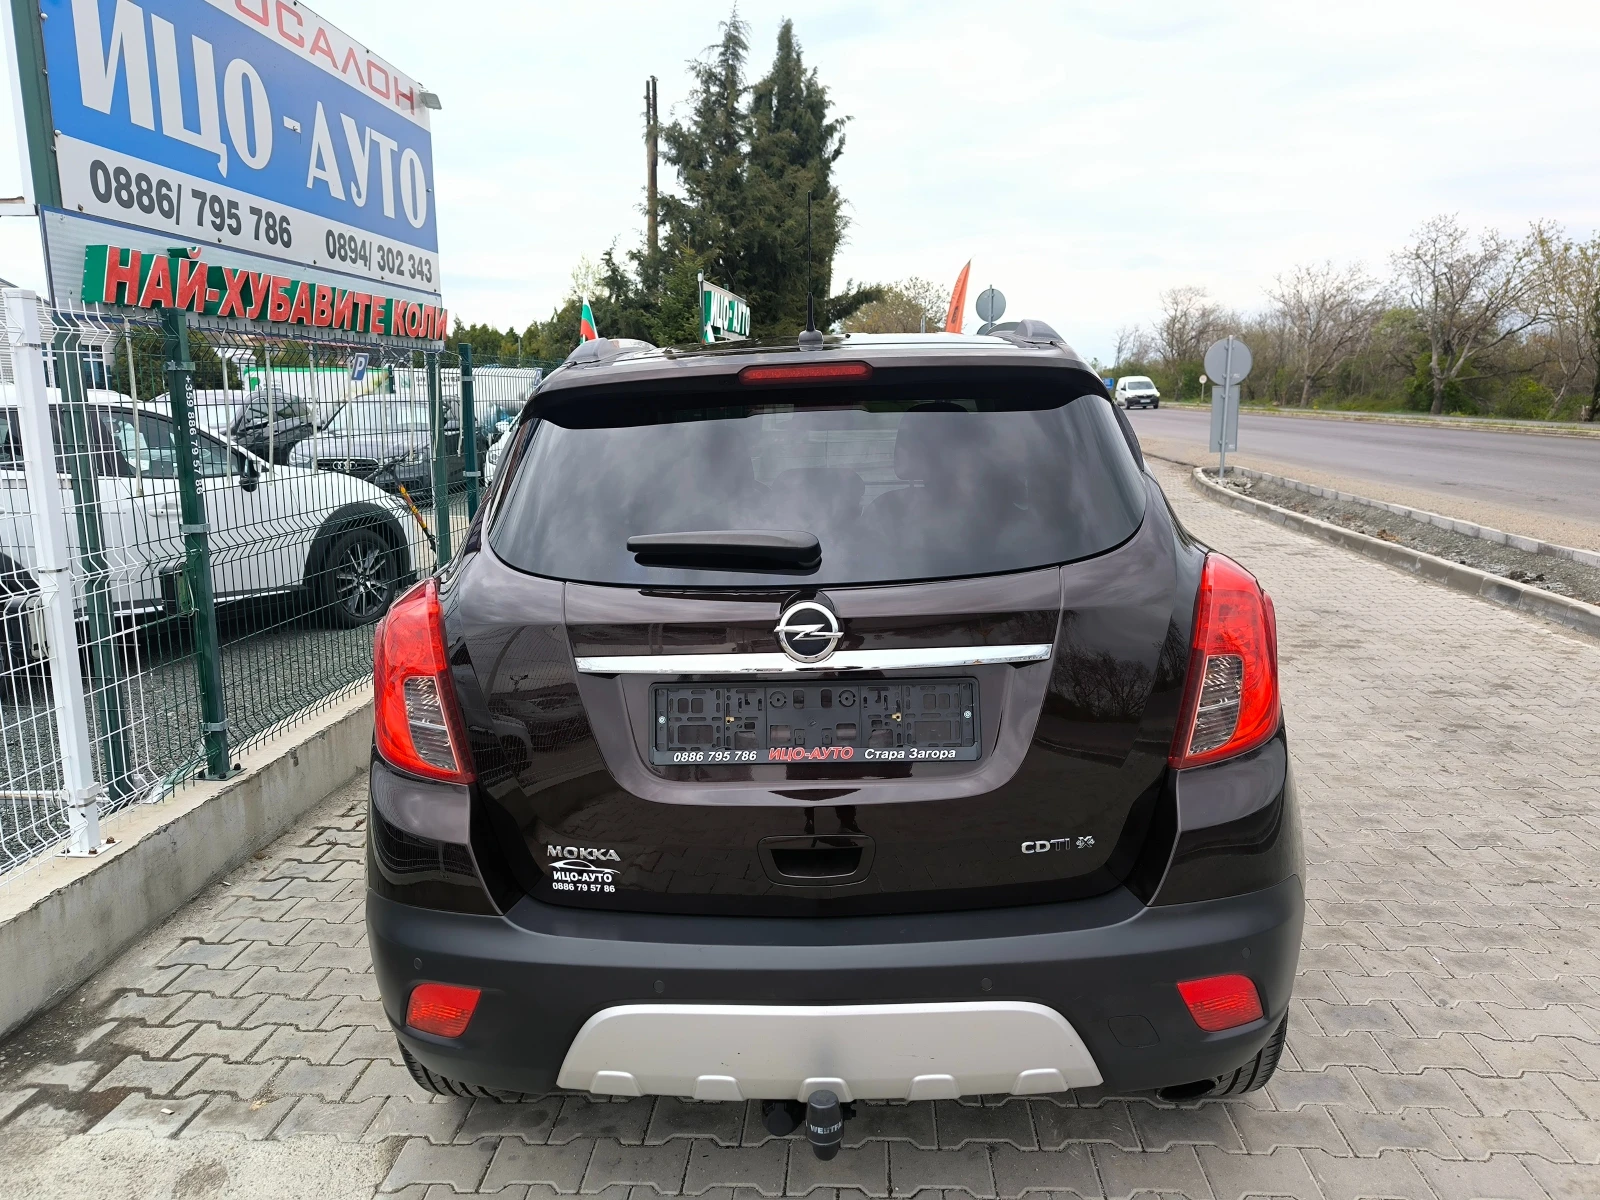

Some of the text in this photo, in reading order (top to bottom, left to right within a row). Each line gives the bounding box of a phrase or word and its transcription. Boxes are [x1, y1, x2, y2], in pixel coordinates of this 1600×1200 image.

[191, 191, 242, 237] 795
[249, 206, 293, 249] 786
[377, 244, 405, 277] 302
[408, 253, 433, 284] 343
[103, 245, 449, 342] НАЙ-ХУБАВИТЕ КОЛИ
[185, 374, 203, 495] +359 886 79 57 86
[673, 750, 757, 762] 0886 795 786
[768, 747, 854, 762] ИЦО-АУТО
[864, 748, 956, 761] Стара Загора
[547, 844, 621, 861] MOKKA
[1021, 838, 1070, 853] CDTI
[553, 870, 612, 883] ИЦО-АУТО
[552, 882, 616, 893] 0886 79 57 86
